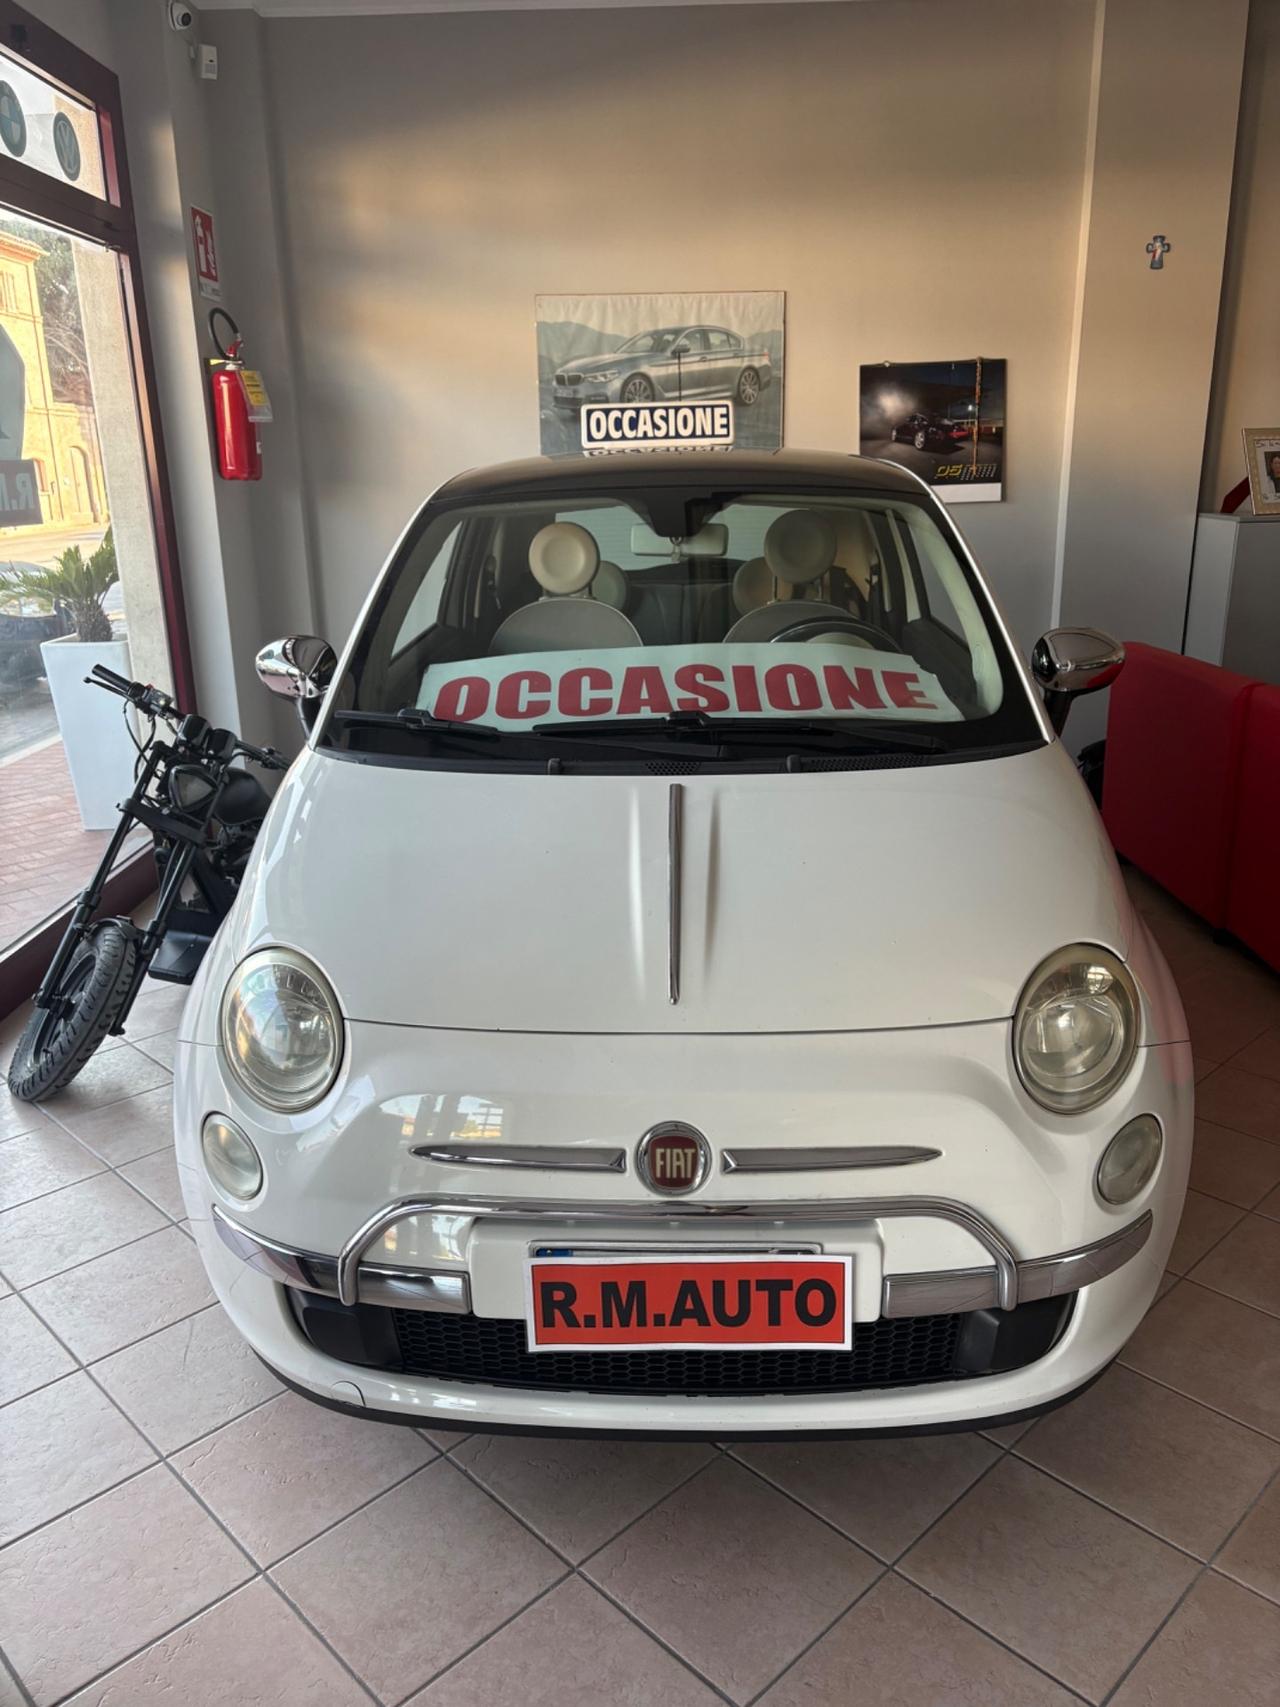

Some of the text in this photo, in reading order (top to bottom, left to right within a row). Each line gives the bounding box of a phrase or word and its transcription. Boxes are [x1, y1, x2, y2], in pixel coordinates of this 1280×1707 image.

[589, 407, 728, 440] OCCASIONE
[434, 663, 938, 722] OCCASIONE
[655, 1148, 696, 1179] FIAT
[540, 1278, 837, 1328] R.M.AUTO
